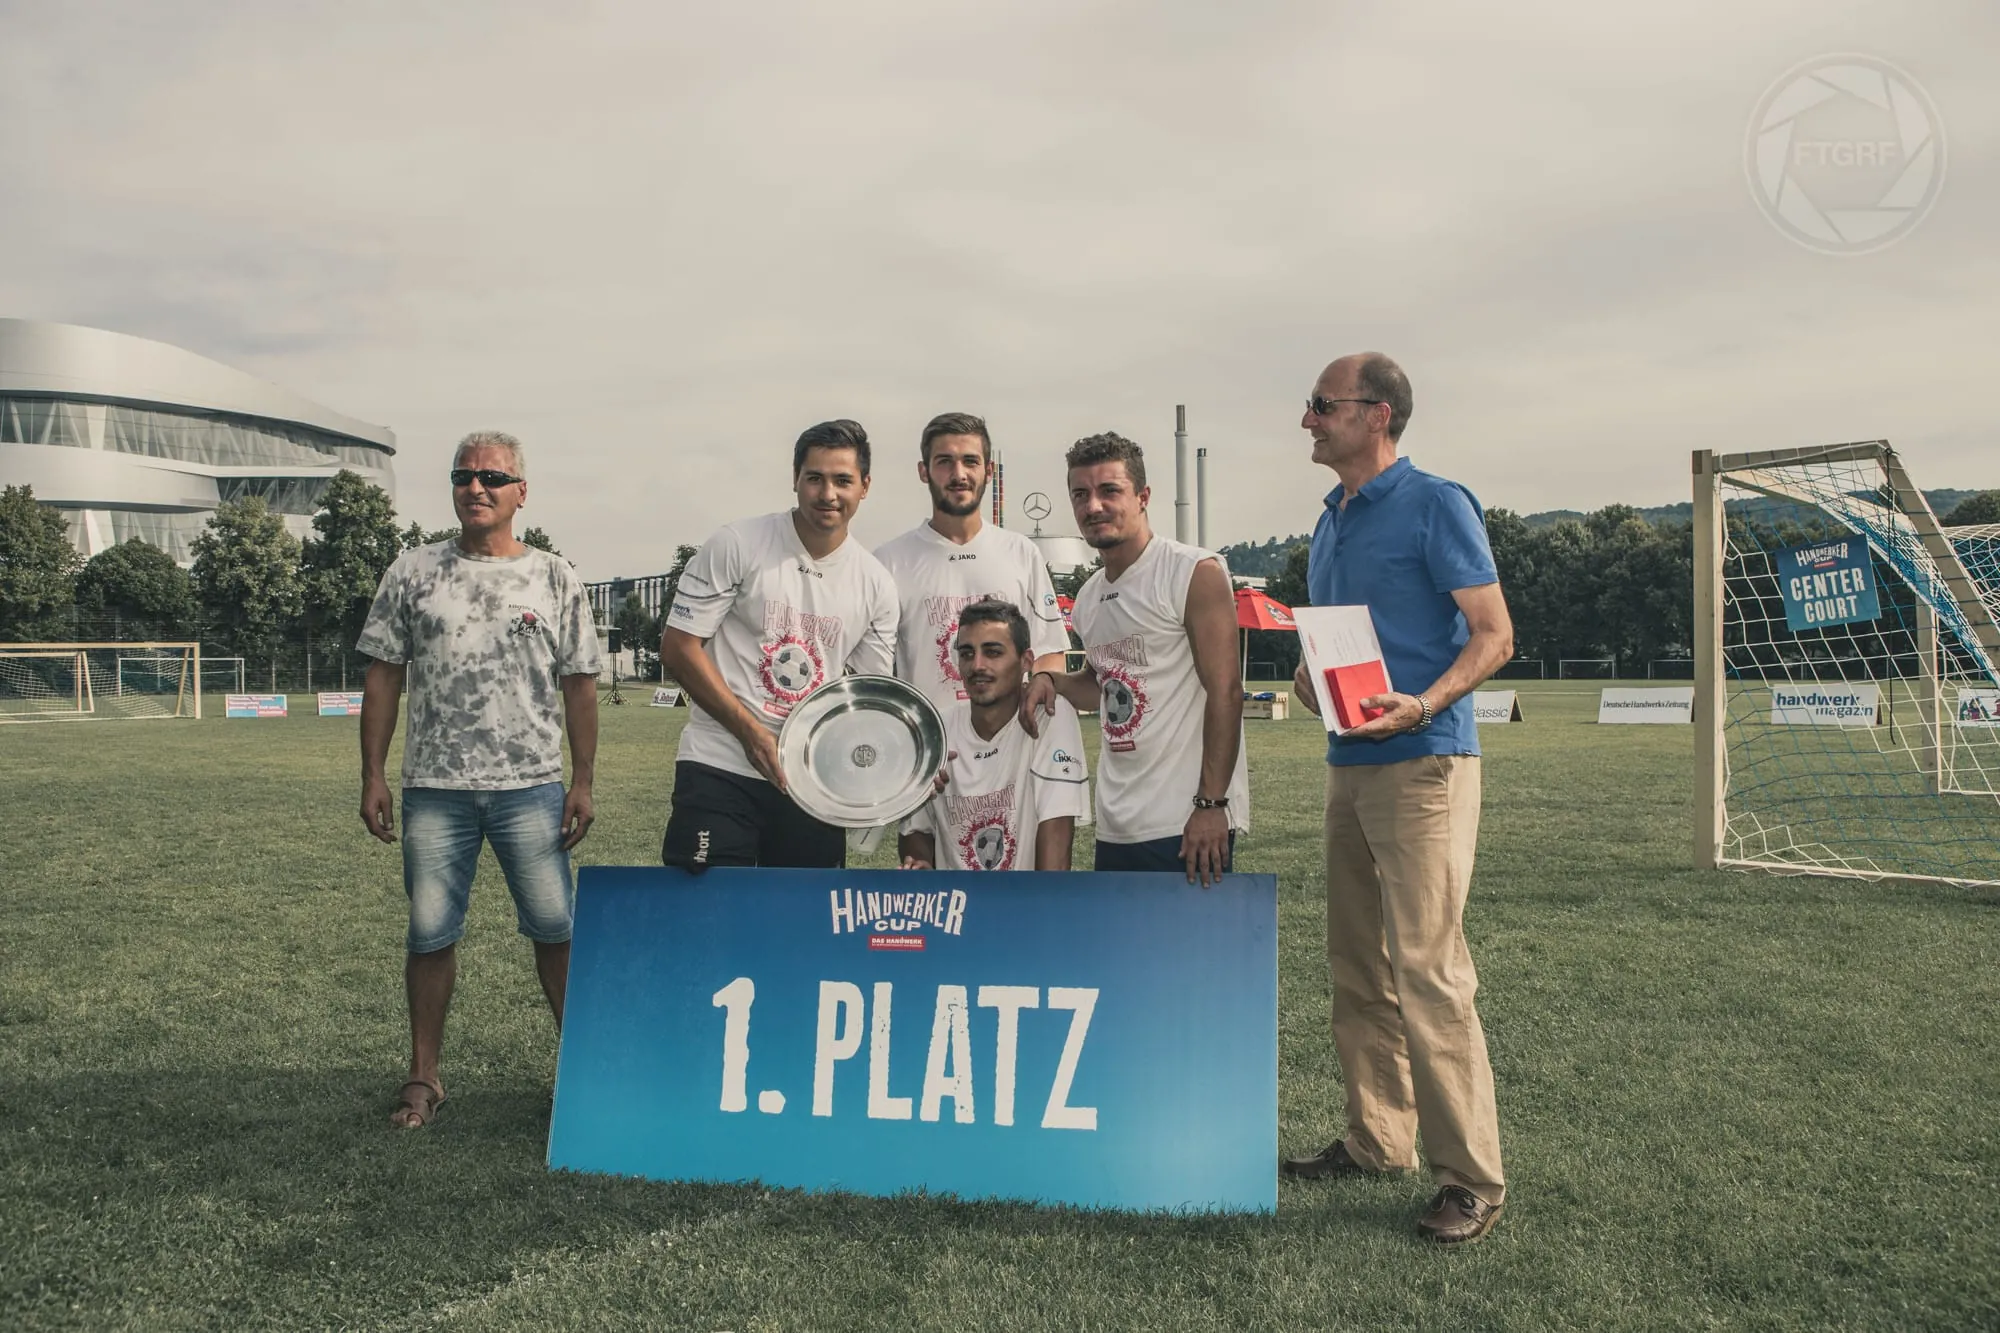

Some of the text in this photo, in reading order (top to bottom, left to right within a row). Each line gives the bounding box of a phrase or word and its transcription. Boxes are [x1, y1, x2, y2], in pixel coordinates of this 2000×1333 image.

[957, 553, 977, 561] JAKO
[1795, 542, 1849, 567] HANDWERKER
[1790, 567, 1866, 602] CENTER
[1803, 595, 1858, 623] COURT
[1776, 692, 1860, 706] handwerk
[1815, 704, 1873, 718] magazin
[983, 747, 999, 760] JAKO
[830, 888, 967, 936] HANDWERKER
[874, 918, 922, 932] CUP
[871, 937, 922, 945] DAS HANDWERK
[712, 977, 1100, 1131] 1. PLATZ
